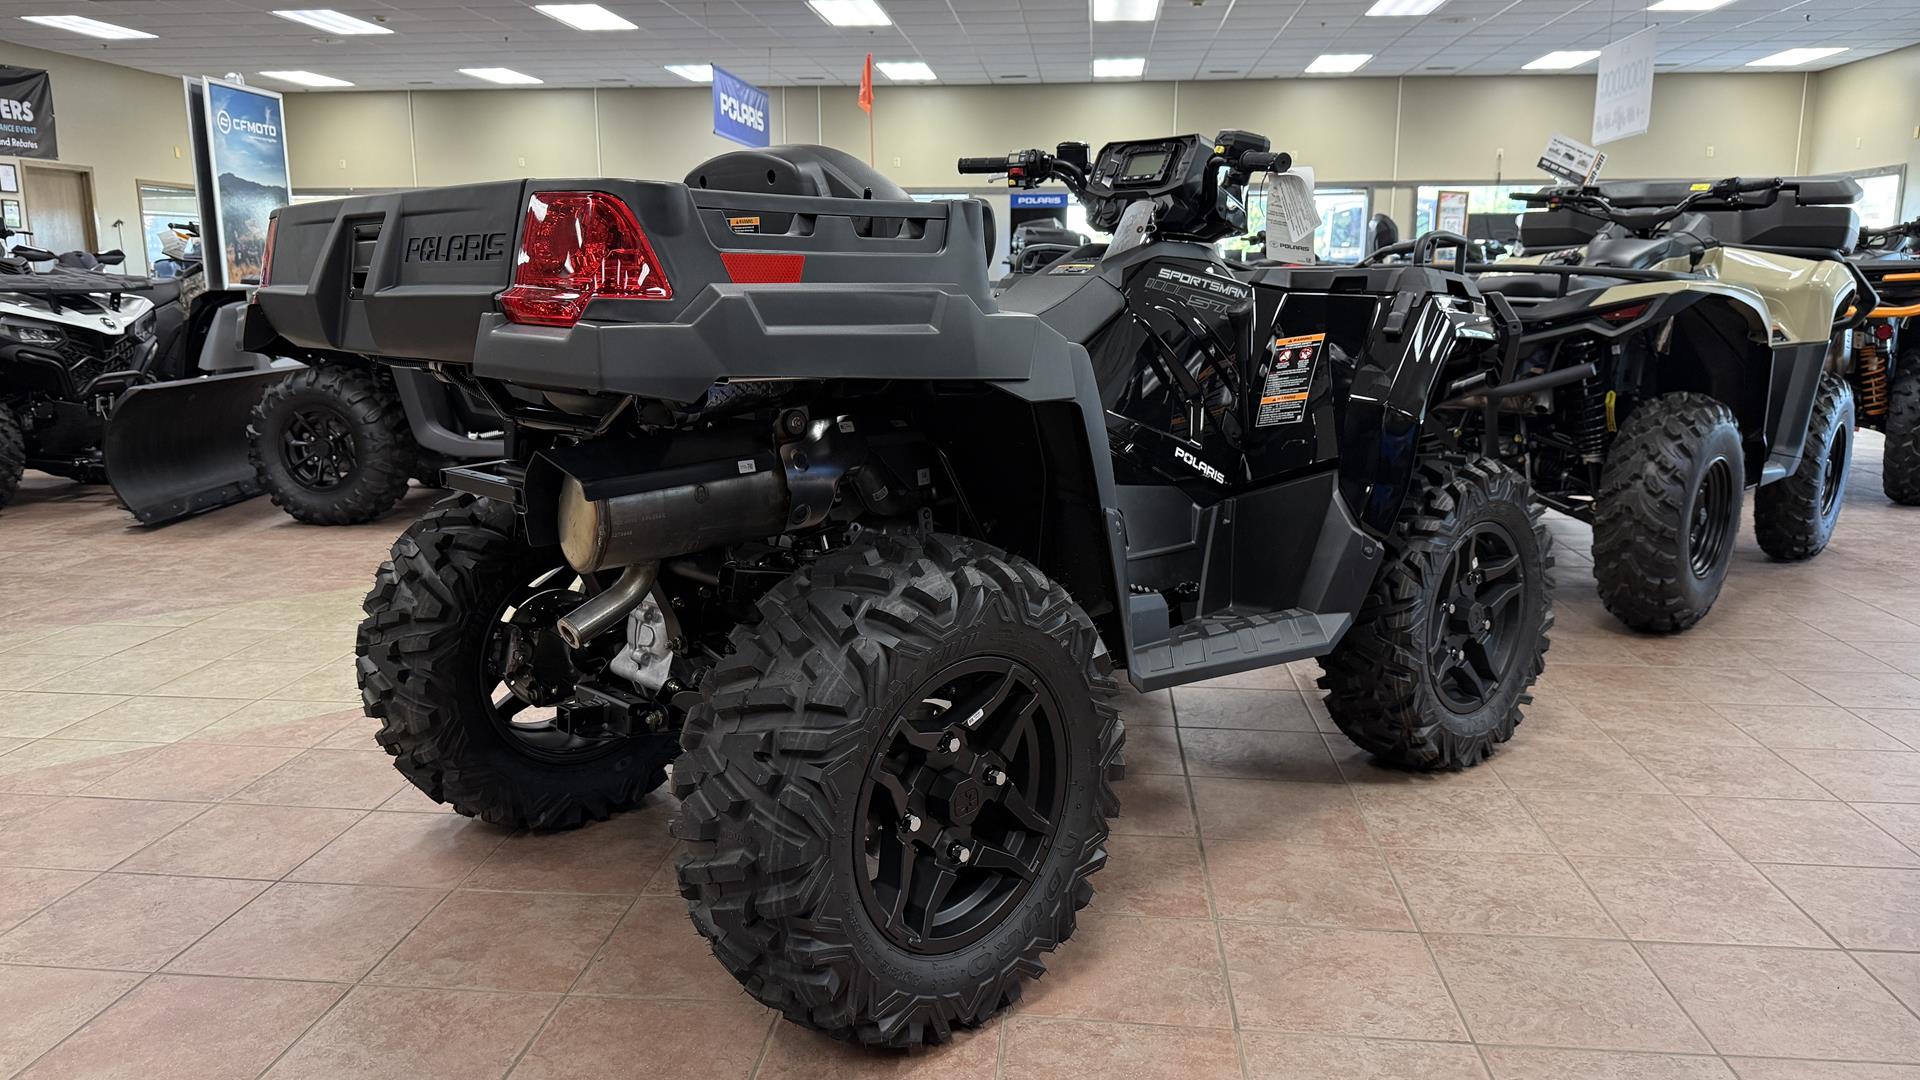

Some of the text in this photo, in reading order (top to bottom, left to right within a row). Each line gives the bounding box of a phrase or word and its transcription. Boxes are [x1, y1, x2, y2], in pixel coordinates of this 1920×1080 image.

[0, 98, 34, 122] ERS
[720, 92, 764, 132] POLARIS
[15, 125, 37, 135] EVENT
[232, 118, 277, 137] CFMOTO
[11, 137, 38, 149] Rebates
[1017, 196, 1062, 205] POLARIS
[405, 233, 507, 262] POLARIS
[1279, 243, 1310, 252] POLARIS
[1158, 267, 1248, 299] SPORTSMAN
[1174, 446, 1225, 485] POLARIS
